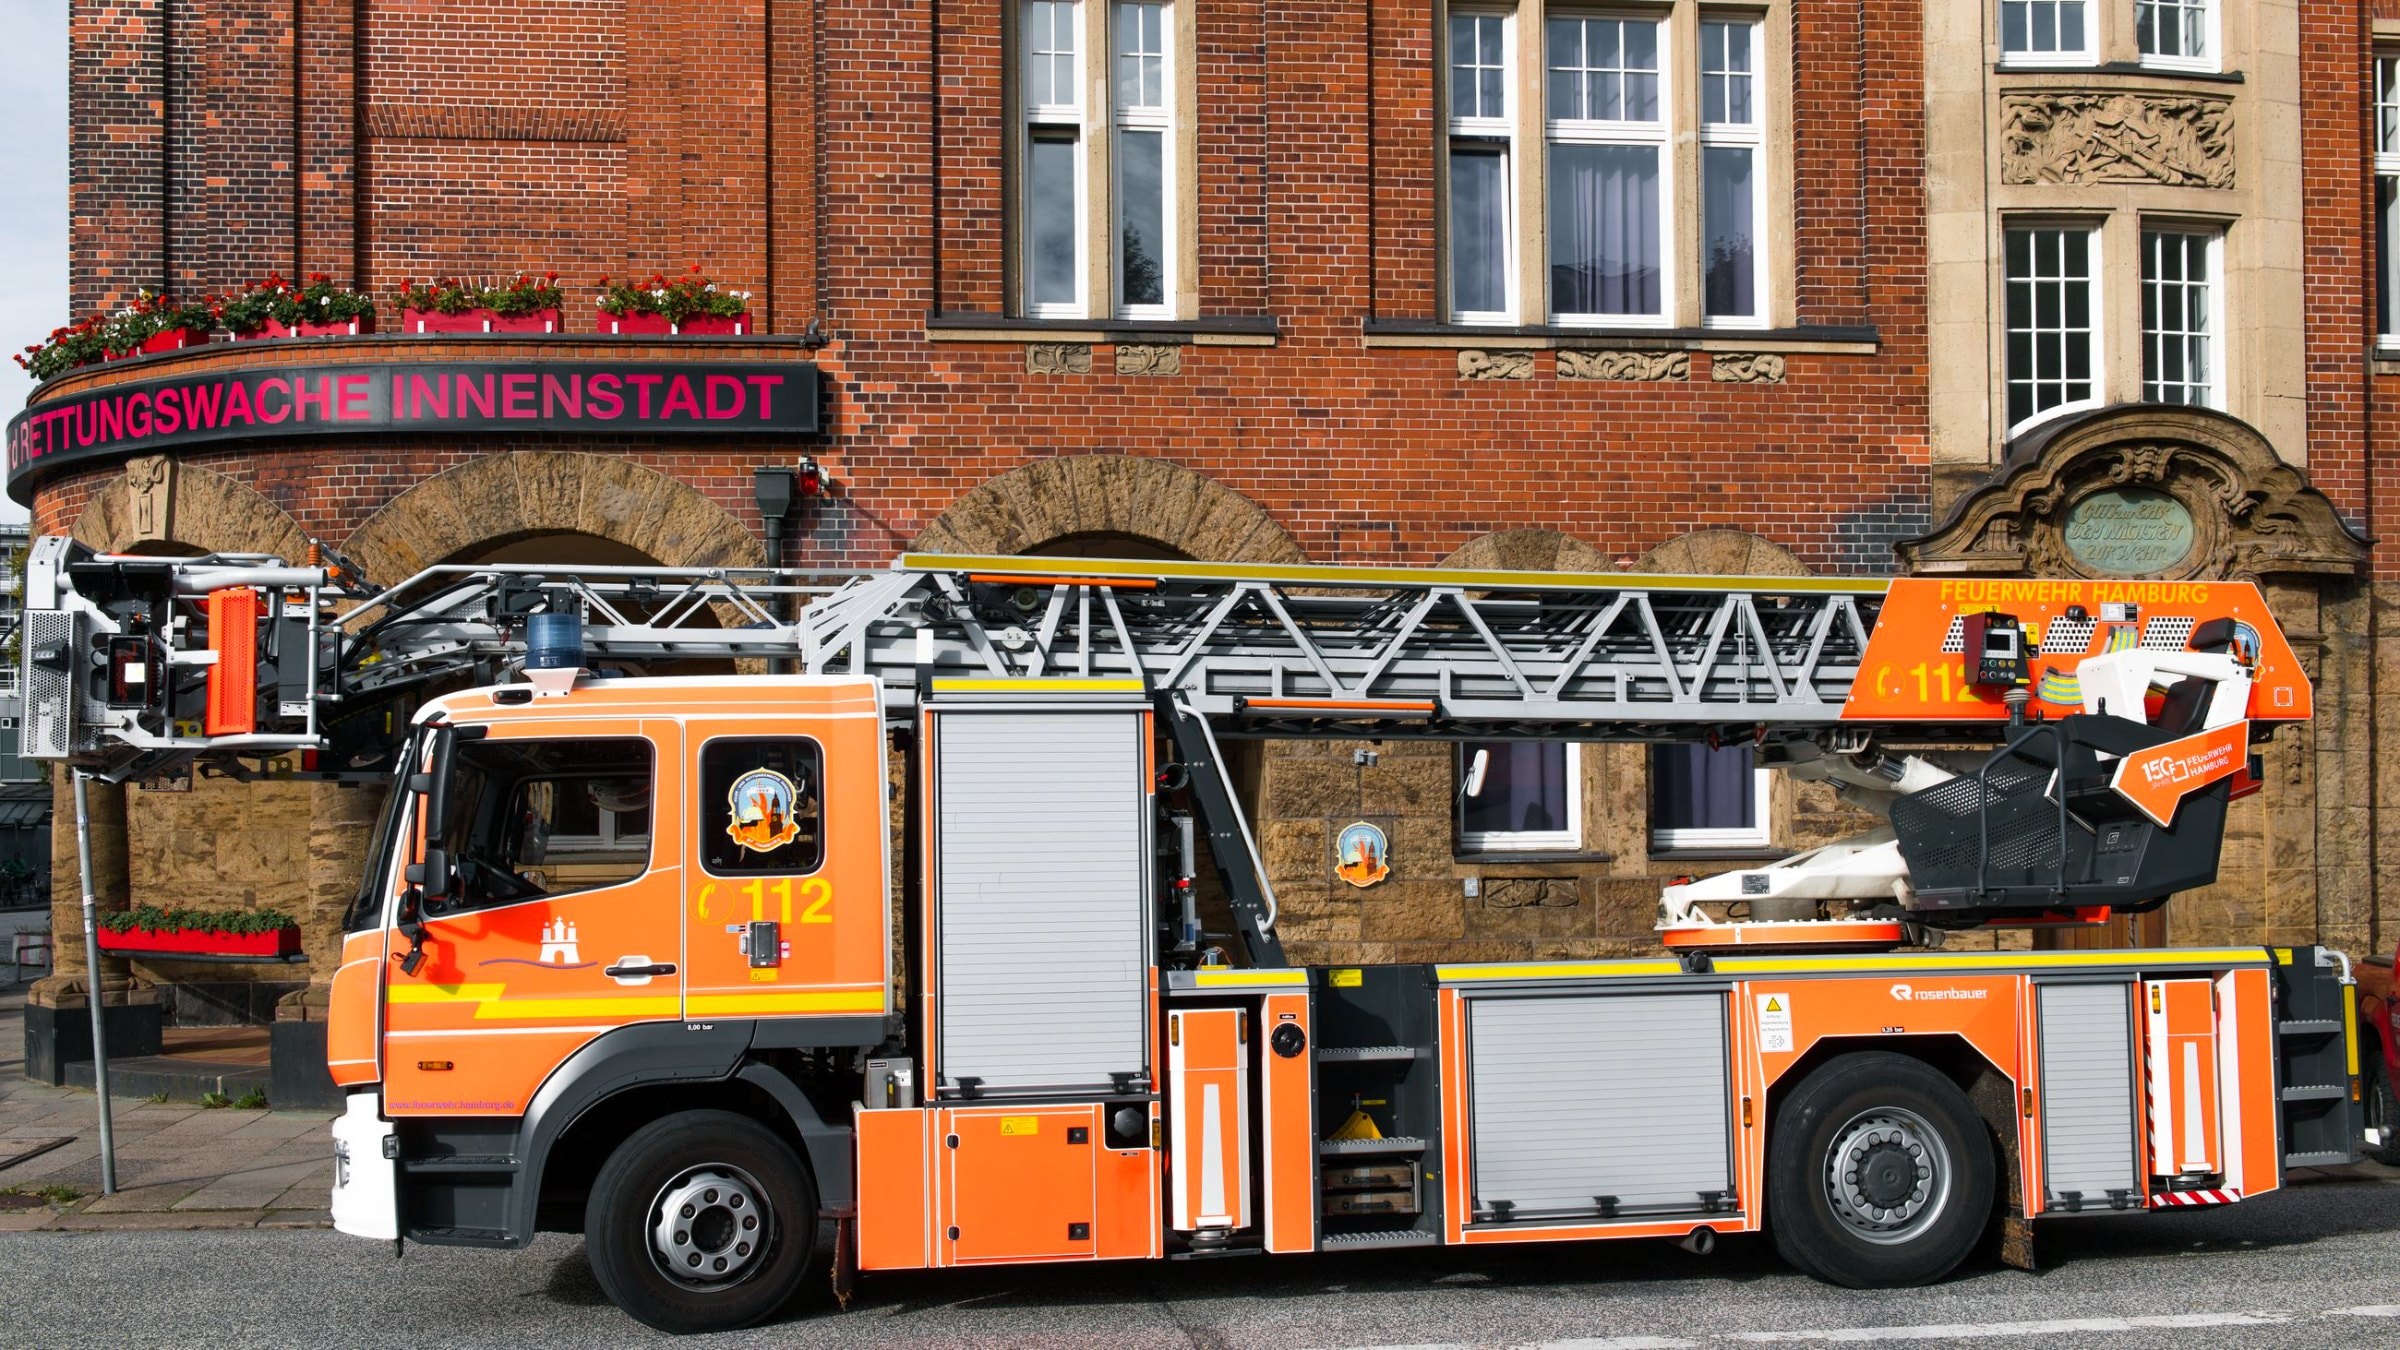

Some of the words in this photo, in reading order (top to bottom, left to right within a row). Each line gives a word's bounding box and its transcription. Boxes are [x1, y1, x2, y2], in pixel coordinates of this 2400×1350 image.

[20, 374, 371, 464] RETTUNGSWACHE
[393, 373, 785, 420] INNENSTADT
[1940, 581, 2082, 603] FEUERWEHR
[2092, 583, 2209, 604] HAMBURG
[2186, 743, 2233, 766] FEUERWEHR
[2190, 756, 2229, 777] HAMBURG
[742, 877, 833, 924] 112
[1915, 986, 1988, 1001] rosenbauer
